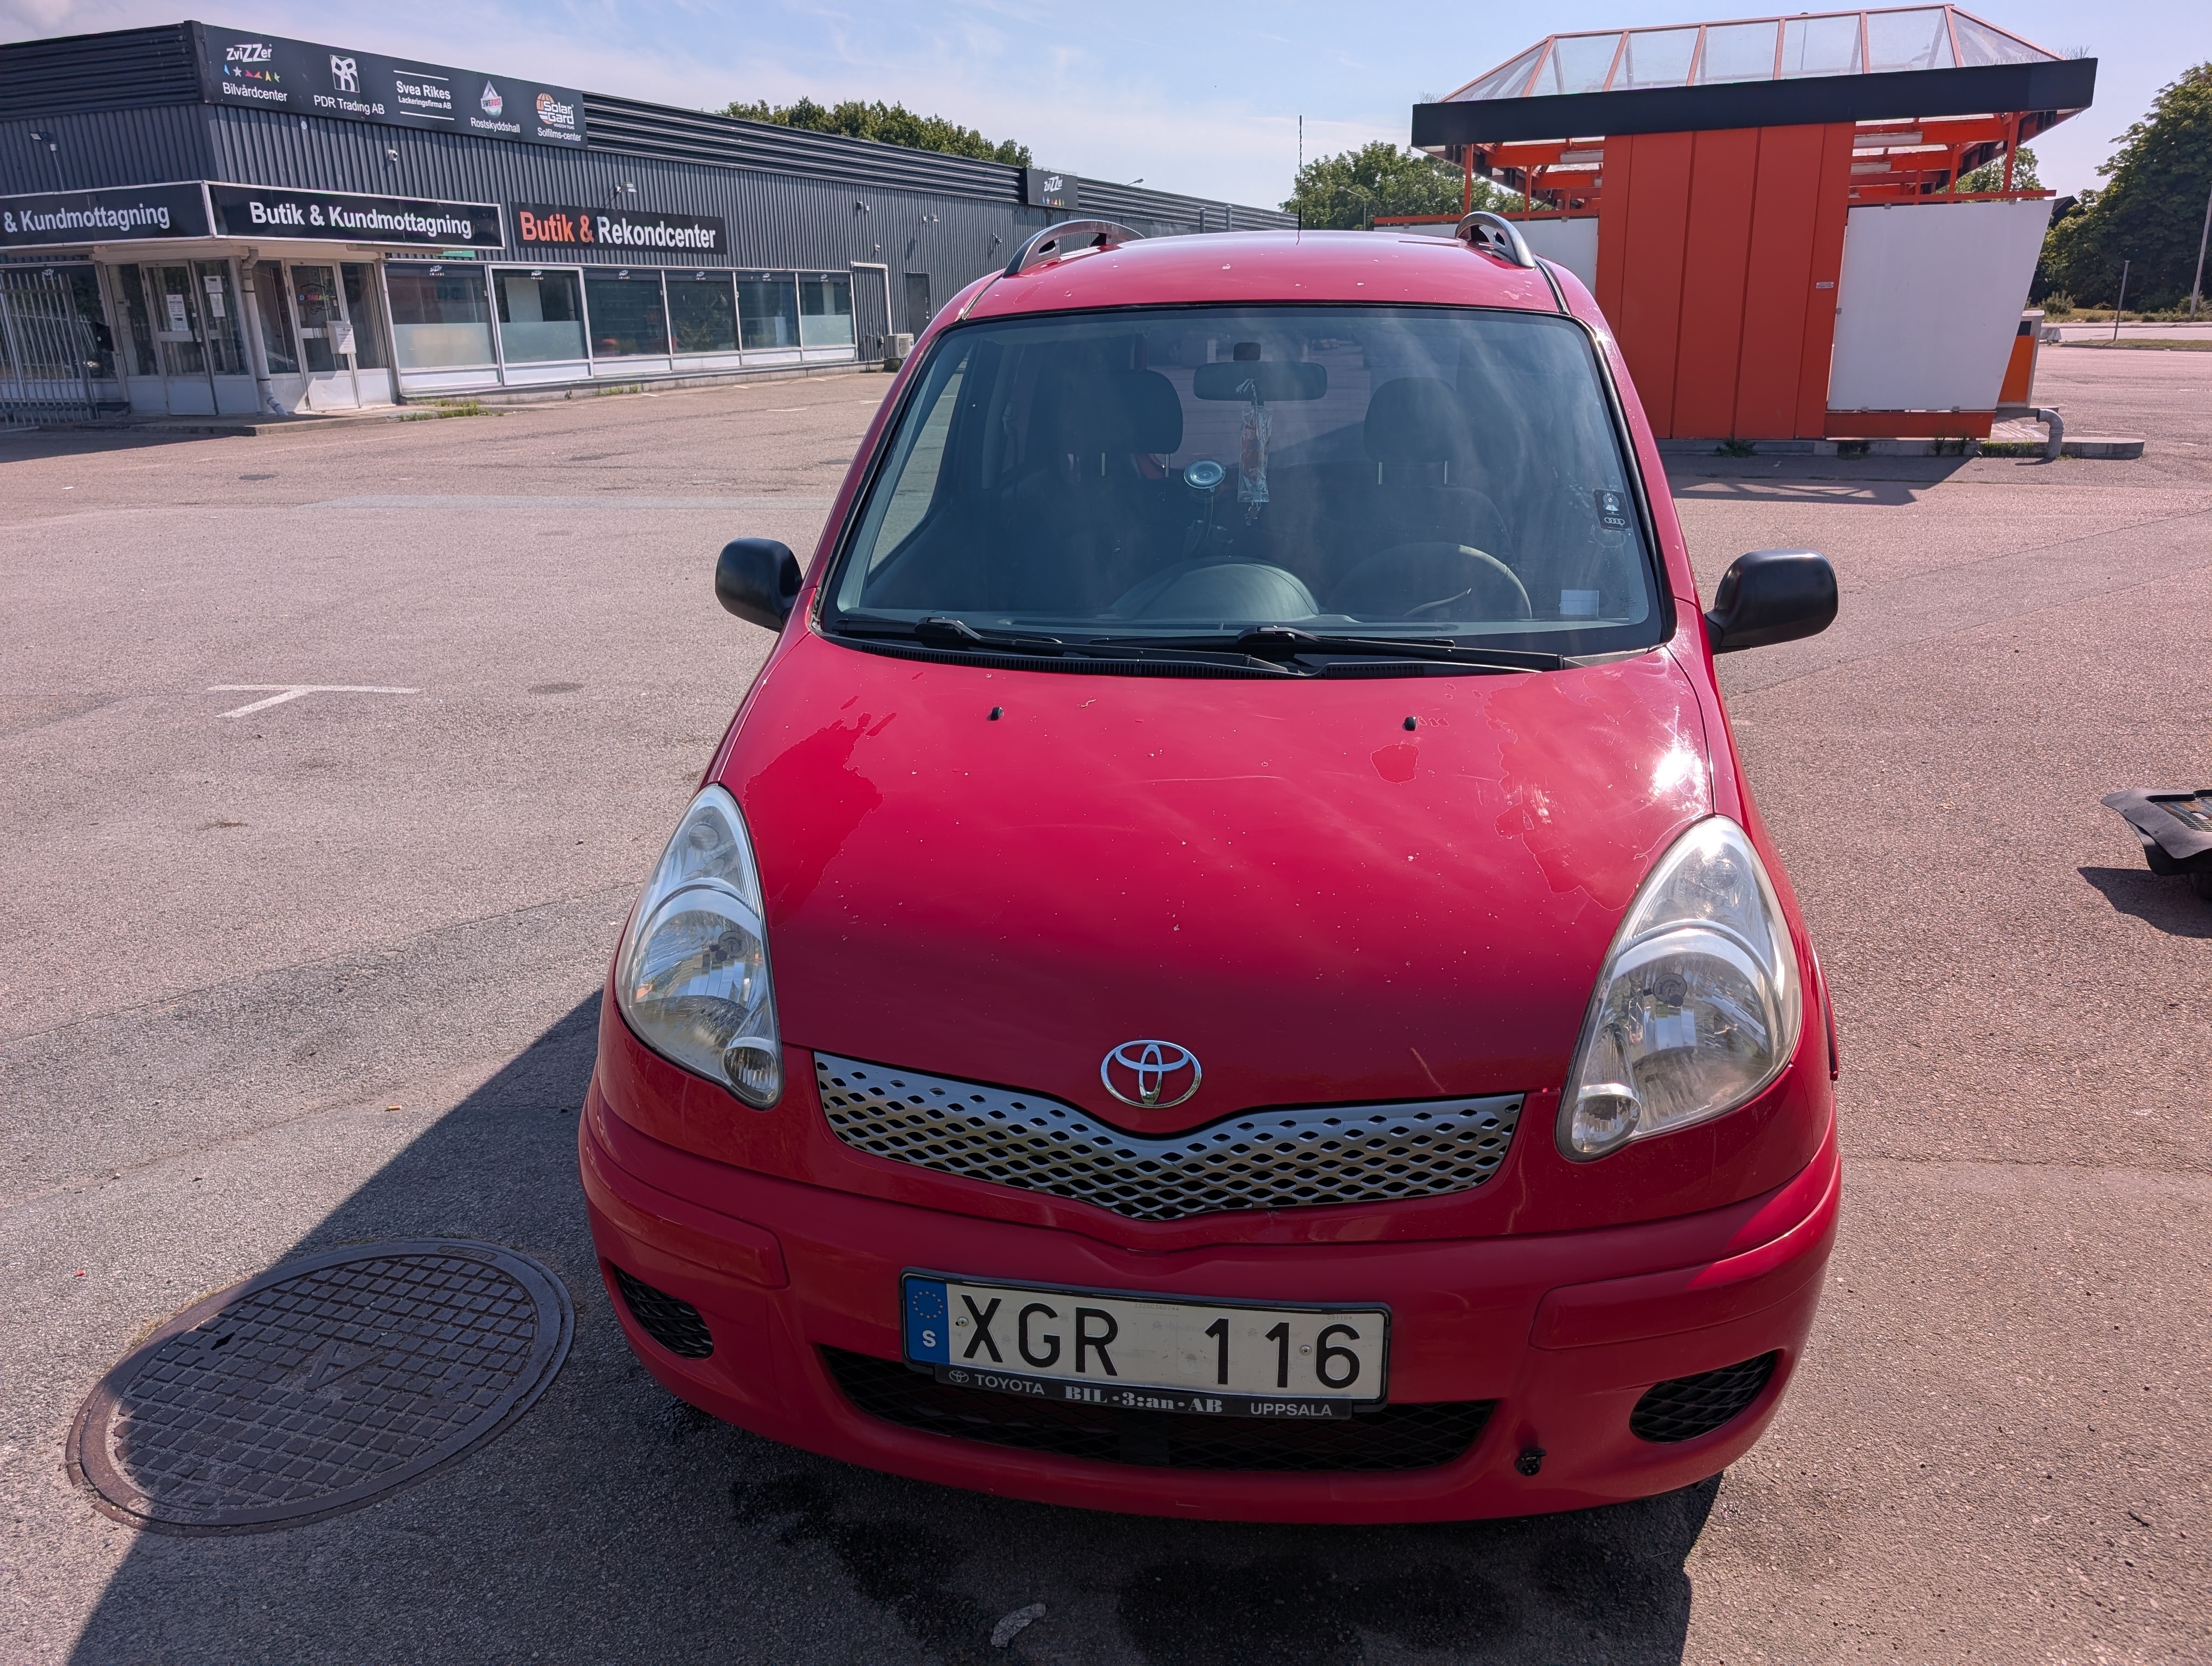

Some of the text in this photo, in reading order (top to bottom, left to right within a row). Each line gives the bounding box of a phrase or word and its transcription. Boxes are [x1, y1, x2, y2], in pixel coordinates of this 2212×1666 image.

[222, 82, 287, 102] Bilvårdcenter
[396, 81, 451, 100] Svea Rikes
[314, 95, 385, 115] PDR Trading AB
[398, 95, 442, 109] Lackeringsfirma
[543, 101, 573, 114] Solar
[470, 117, 520, 133] Rostskyddshall
[548, 111, 575, 125] Gard
[537, 127, 581, 142] Solfilms-center
[4, 203, 170, 233] & Kundmottagning
[249, 202, 472, 239] Butik & Kundmottagning
[519, 211, 716, 248] Butik & Rekondcenter
[922, 1330, 936, 1347] S
[961, 1294, 1361, 1389] XGR 116
[974, 1373, 1045, 1395] TOYOTA
[1064, 1385, 1108, 1404] BIL
[1250, 1402, 1333, 1417] UPPSALA
